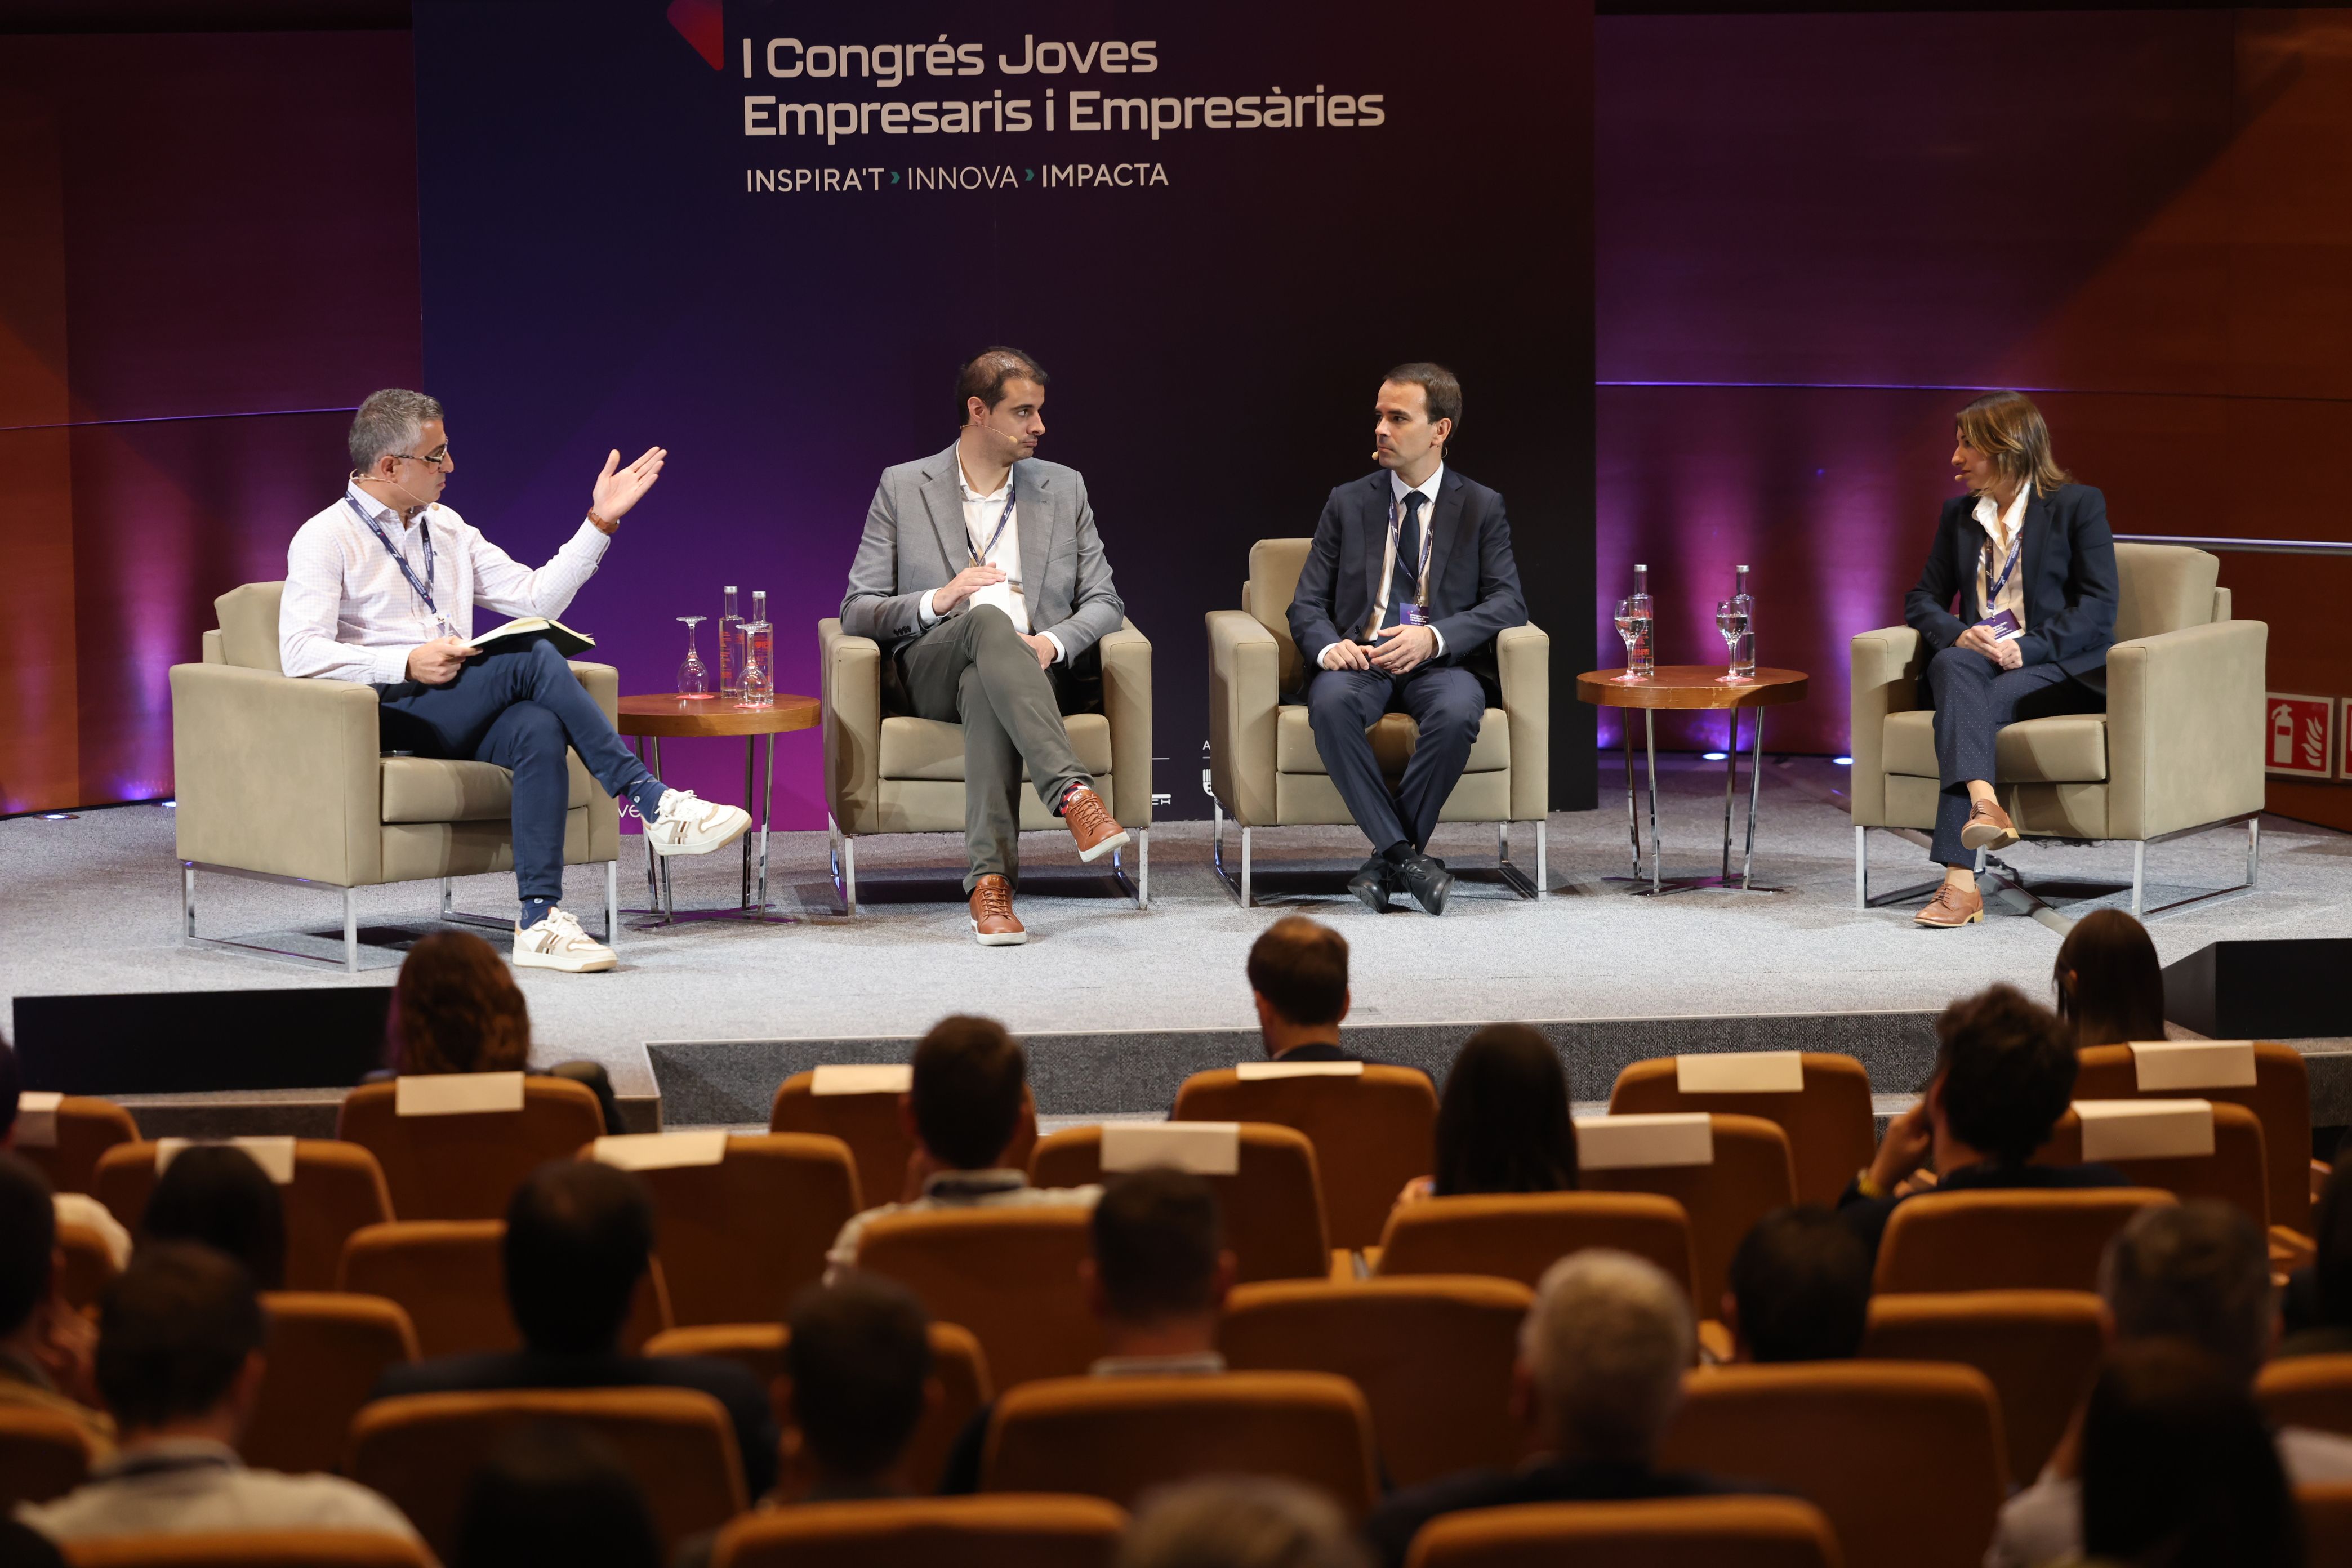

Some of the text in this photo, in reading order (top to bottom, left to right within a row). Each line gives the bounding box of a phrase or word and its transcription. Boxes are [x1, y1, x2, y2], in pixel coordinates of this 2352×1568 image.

[743, 34, 1158, 87] I Congrés Joves
[744, 84, 1385, 145] Empresaris i Empresàries
[747, 163, 1169, 192] INSPIRA'T INNOVA IMPACTA
